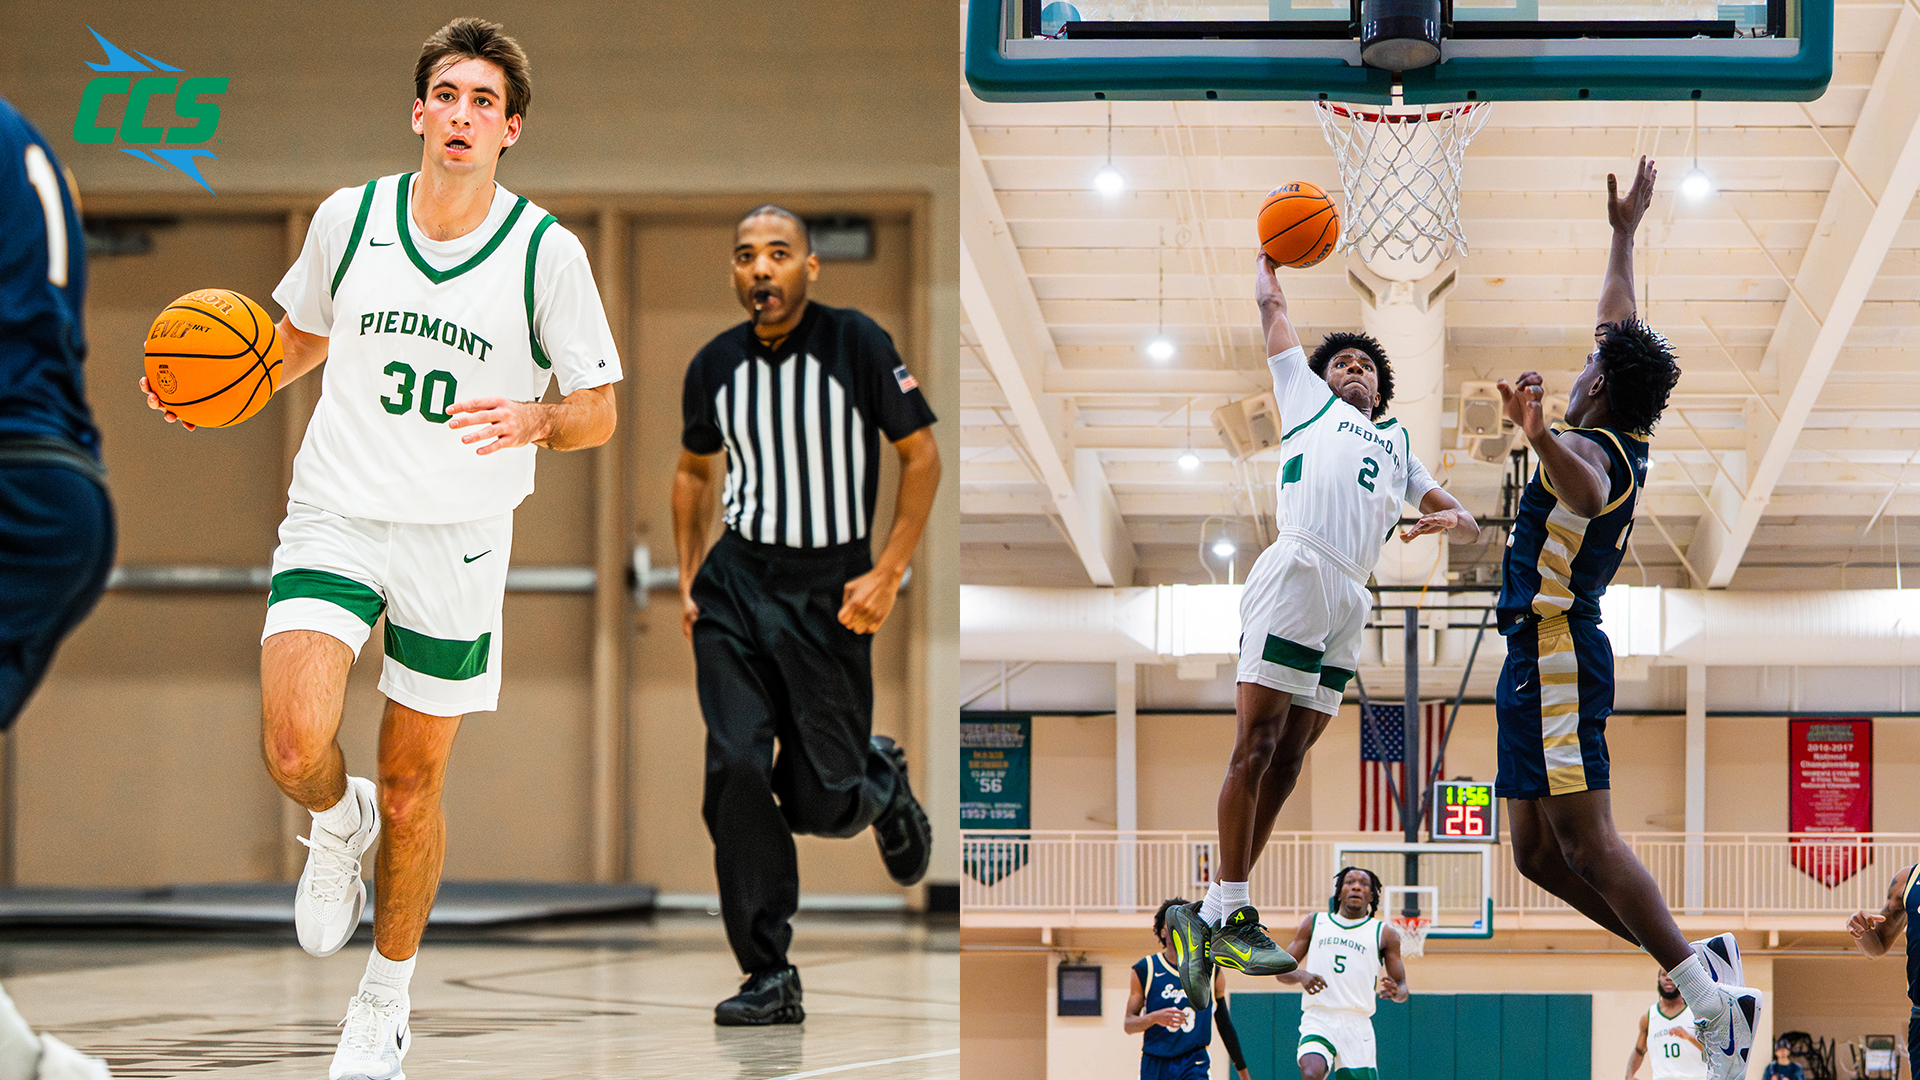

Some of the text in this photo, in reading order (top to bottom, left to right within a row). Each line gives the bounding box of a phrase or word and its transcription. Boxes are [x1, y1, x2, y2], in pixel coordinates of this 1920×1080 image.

[24, 143, 69, 288] 1
[359, 311, 493, 362] PIEDMONT
[380, 360, 458, 424] 30
[1357, 456, 1380, 494] 2
[1446, 786, 1490, 806] 11:56
[1444, 805, 1484, 837] 26
[1318, 936, 1367, 955] PIEDMONT
[1333, 954, 1347, 974] 5
[1663, 1043, 1681, 1058] 10
